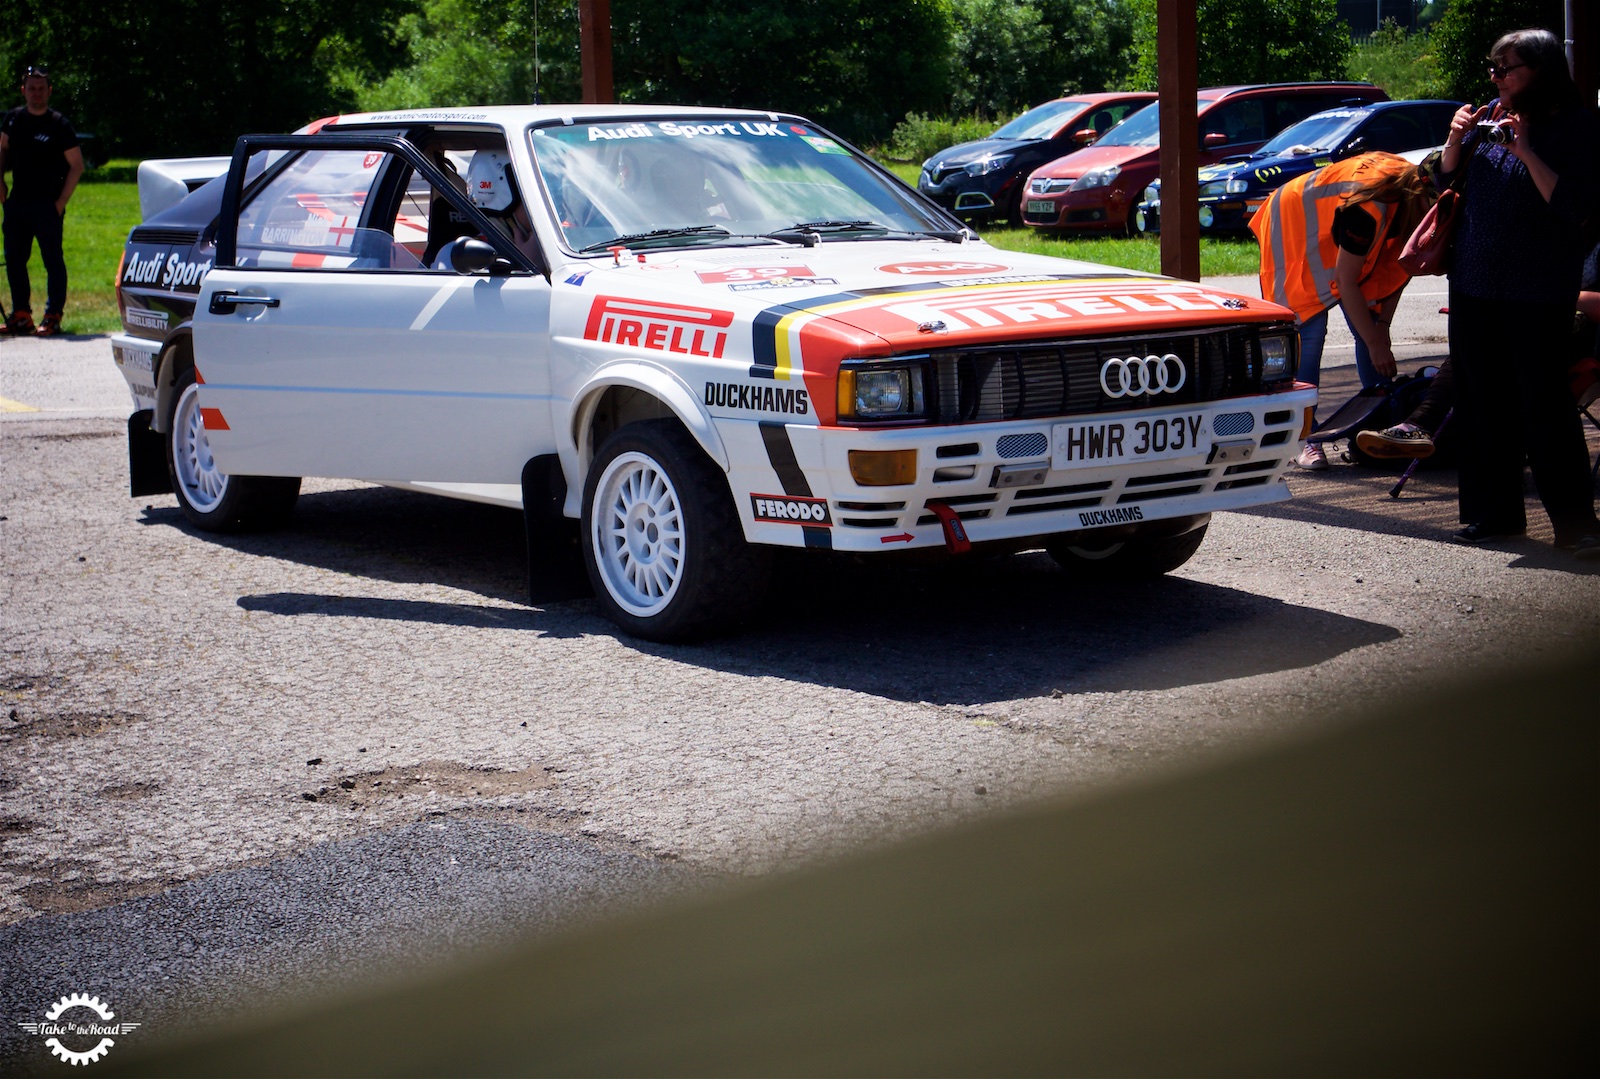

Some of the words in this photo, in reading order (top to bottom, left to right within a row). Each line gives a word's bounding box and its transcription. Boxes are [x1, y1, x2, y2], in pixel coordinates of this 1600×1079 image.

[369, 112, 488, 121] www.iconic-motorsport.com
[587, 123, 654, 142] Audi
[658, 121, 742, 139] Sport
[739, 122, 789, 138] UK
[480, 181, 492, 189] 3M
[260, 227, 327, 244] BARRINGTON
[123, 251, 166, 283] Audi
[163, 252, 212, 294] Sport
[723, 267, 789, 281] 39
[882, 283, 1231, 332] PIRELLI
[583, 294, 735, 359] PIRELLI
[705, 381, 808, 415] DUCKHAMS
[1067, 423, 1125, 461] HWR
[1133, 414, 1202, 455] 303Y
[755, 498, 827, 521] FERODO
[1078, 506, 1144, 527] DUCKHAMS
